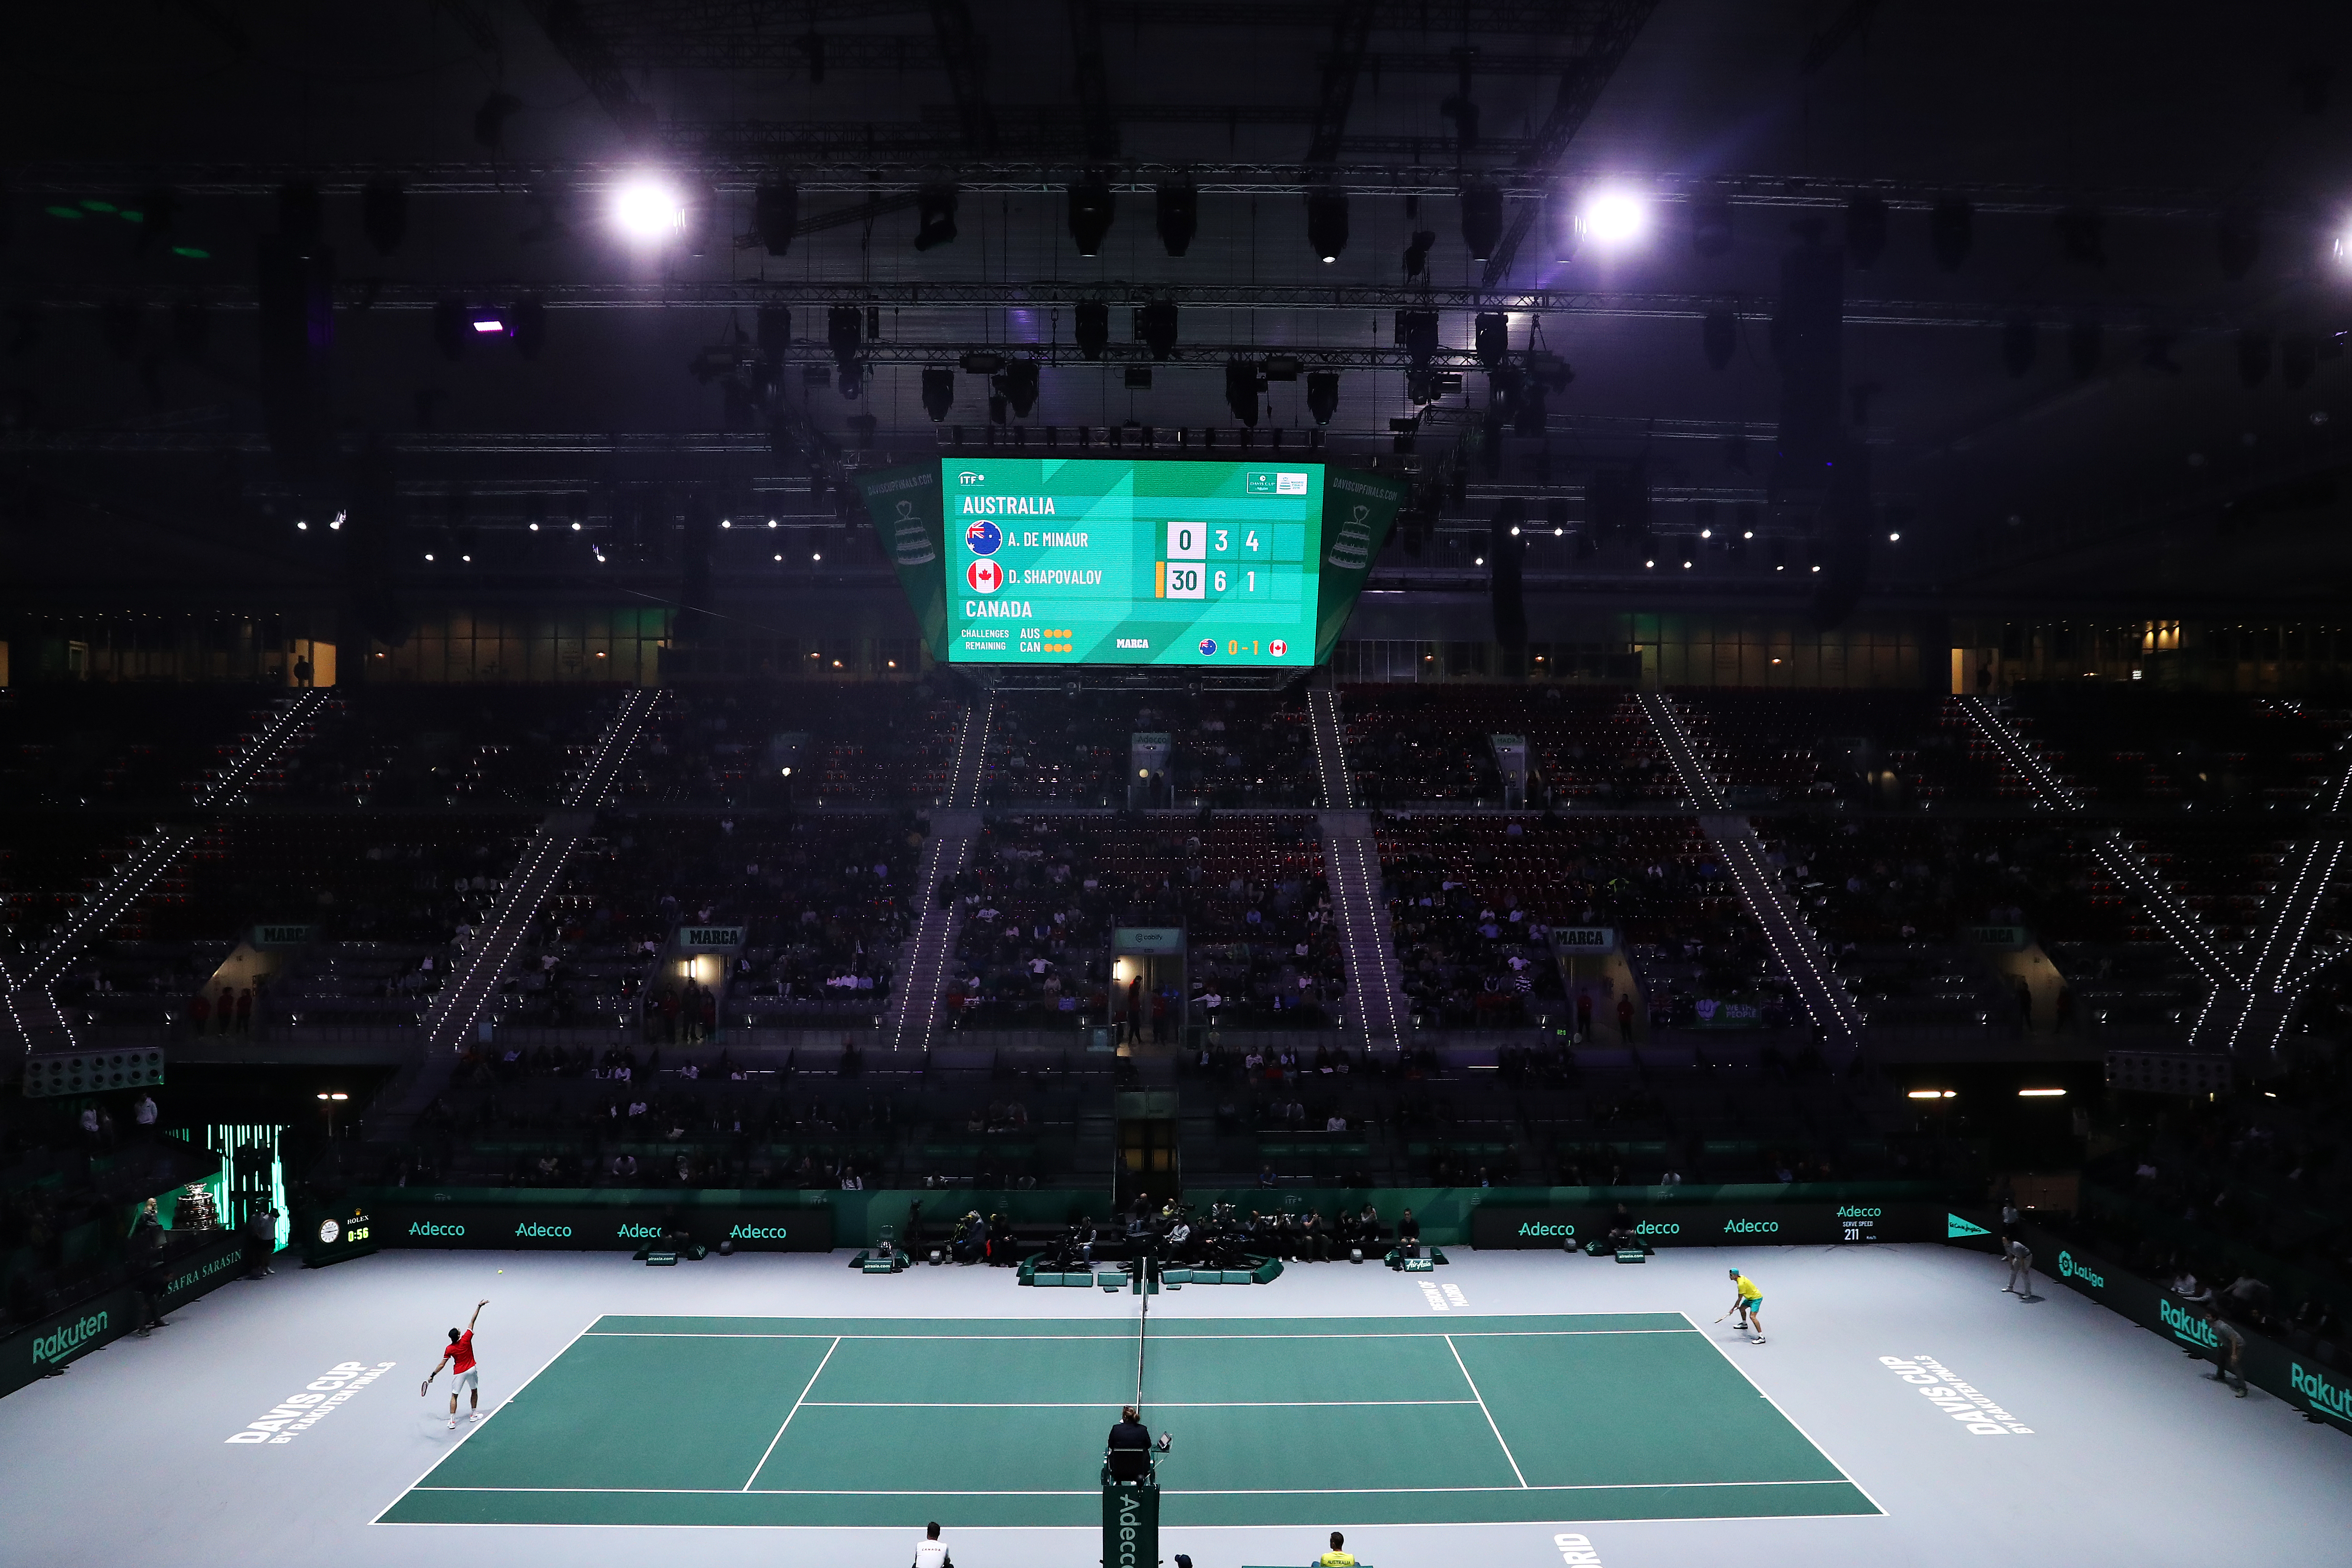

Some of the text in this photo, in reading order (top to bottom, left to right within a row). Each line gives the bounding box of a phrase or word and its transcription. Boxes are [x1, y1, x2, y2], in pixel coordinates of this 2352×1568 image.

[868, 474, 932, 495] DAVISCUPFINALS.COM
[960, 476, 976, 484] ITF
[1333, 477, 1397, 501] DAVISCUPFINALS.COM
[963, 496, 1055, 515] AUSTRALIA
[1008, 532, 1088, 547] A. DE MINAUR
[1179, 529, 1191, 550] 0
[1215, 530, 1228, 551] 3
[1246, 530, 1259, 552] 4
[1009, 570, 1102, 584] D. SHAPOVALOV
[1172, 570, 1197, 590] 30
[1214, 570, 1227, 592] 6
[1247, 571, 1255, 592] 1
[965, 601, 1032, 617] CANADA
[961, 629, 1009, 638] CHALLENGES
[1020, 628, 1040, 639] AUS
[965, 641, 1006, 650] REMAINING
[1020, 641, 1041, 652] CAN
[1116, 639, 1149, 648] MARCA
[690, 930, 737, 944] MARCA
[1556, 931, 1604, 945] MARCA
[1836, 1205, 1881, 1217] Adecco
[347, 1215, 369, 1224] ROLEX
[1724, 1218, 1779, 1233] Adecco
[348, 1227, 369, 1242] 0:56
[409, 1222, 465, 1236] Adecco
[515, 1223, 572, 1237] Adecco
[617, 1223, 661, 1238] Adecc
[729, 1224, 786, 1238] Adecco
[1518, 1222, 1575, 1236] Adecco
[1634, 1221, 1680, 1234] decco
[1844, 1228, 1859, 1240] 211
[167, 1271, 199, 1295] SAFRA
[202, 1249, 242, 1277] SARASIN
[2074, 1262, 2104, 1288] LaLiga
[1417, 1280, 1450, 1311] REGION OF
[1441, 1283, 1470, 1307] MADRID
[2160, 1298, 2218, 1347] Rakute
[33, 1311, 108, 1364] Rakuten
[1878, 1355, 2011, 1435] DAVIS CUP
[1914, 1354, 2035, 1434] BY RAKUTEN FINALS
[2291, 1362, 2352, 1418] Rakut
[223, 1361, 368, 1444] DAVIS CUP
[267, 1361, 397, 1444] BY RAKUTEN FINALS
